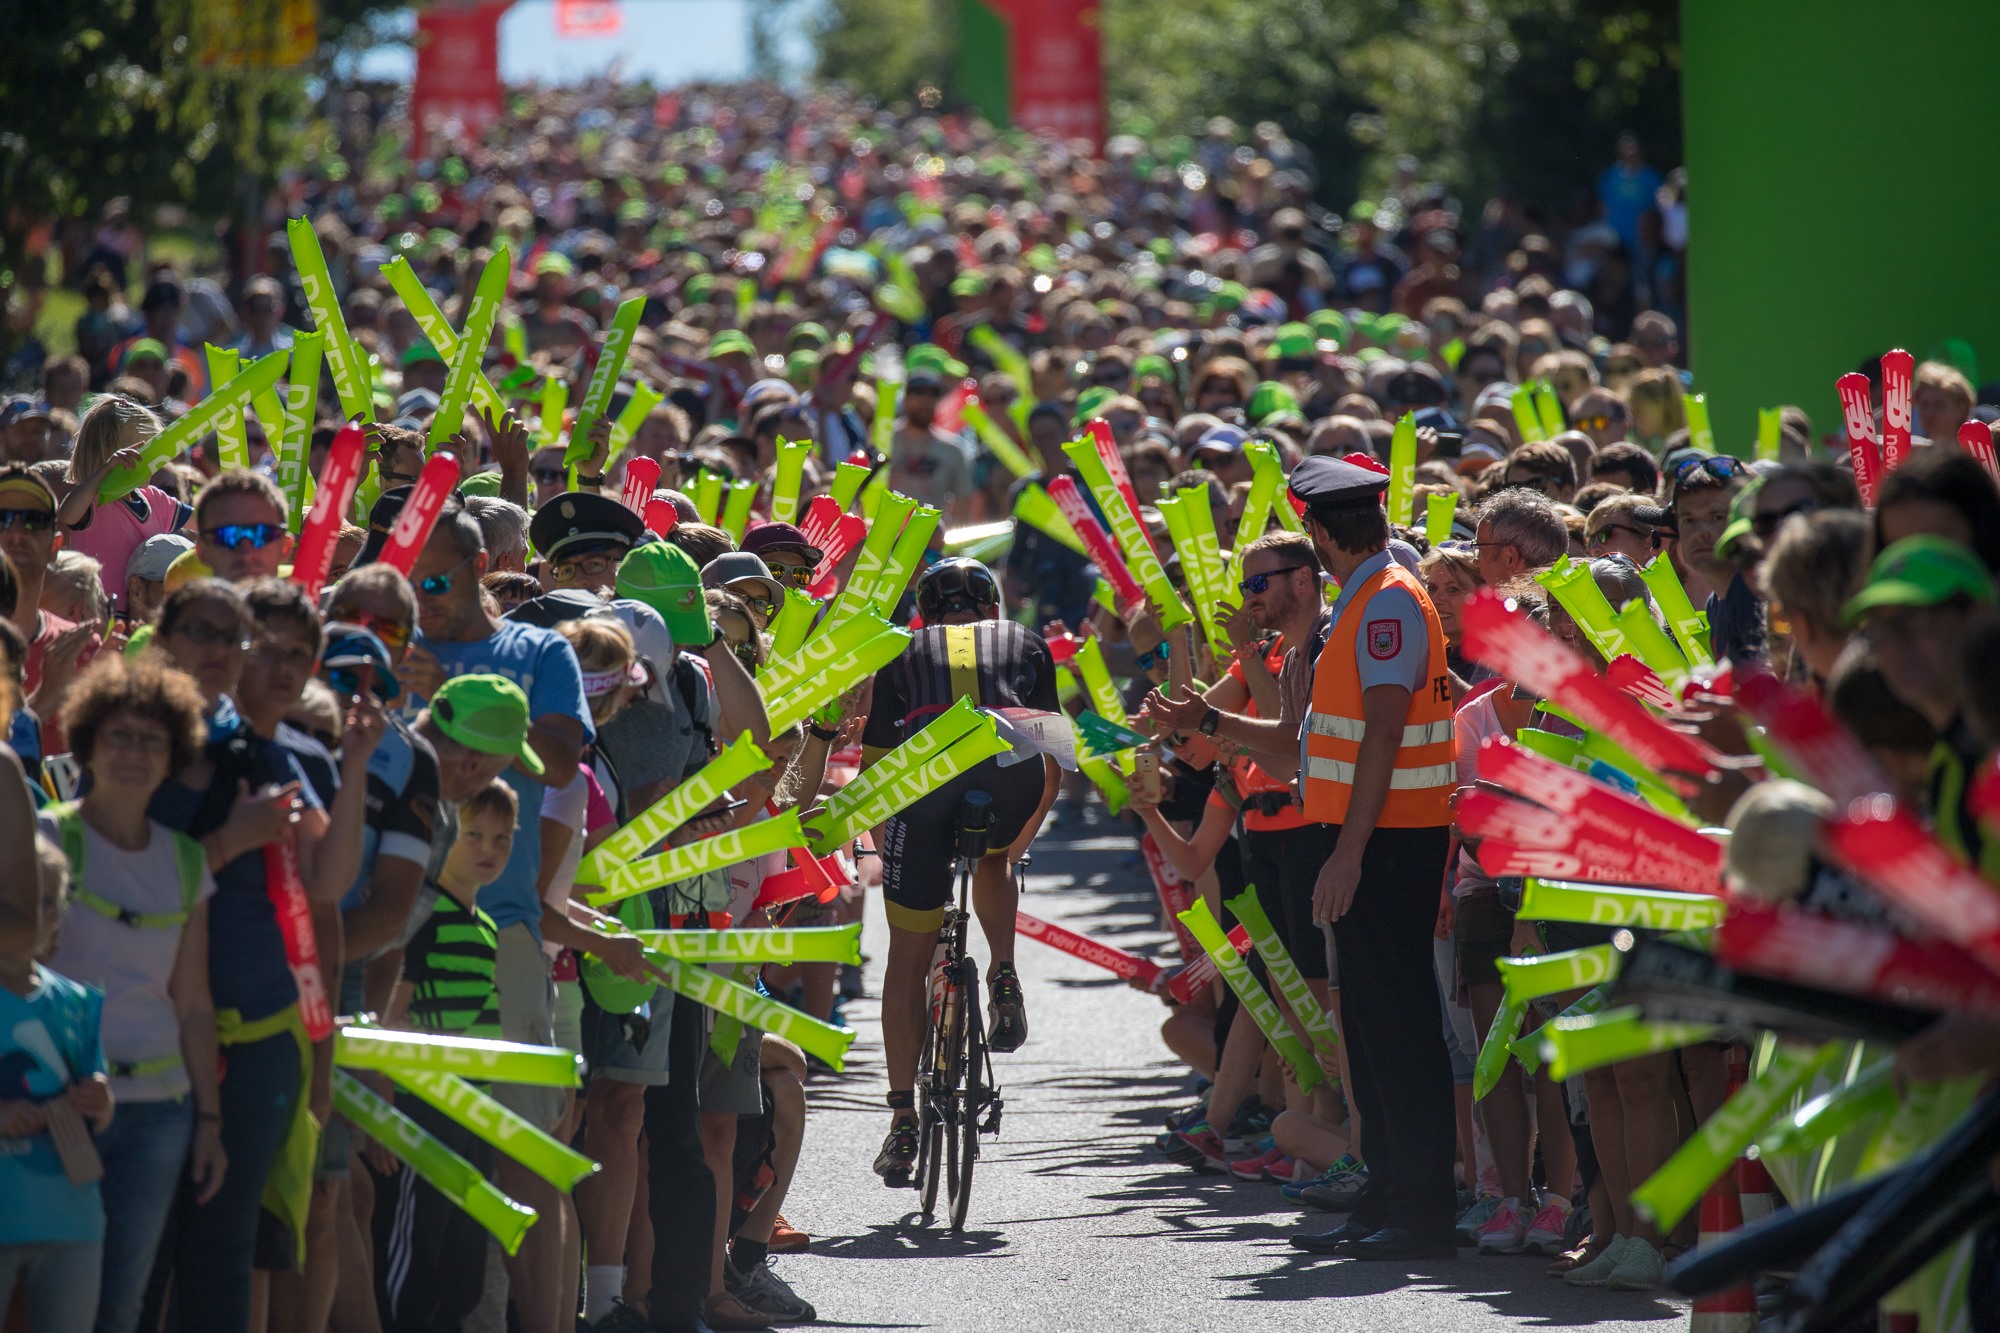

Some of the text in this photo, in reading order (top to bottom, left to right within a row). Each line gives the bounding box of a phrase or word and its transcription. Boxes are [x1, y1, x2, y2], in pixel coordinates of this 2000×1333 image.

[301, 274, 354, 398] DATEV
[282, 384, 311, 514] DATEV
[1852, 446, 1869, 482] new
[1095, 484, 1164, 586] DATEV
[828, 728, 937, 820] DATEV
[846, 750, 959, 836] DATEV
[593, 774, 716, 879] DATEV
[609, 829, 745, 897] DATEV
[893, 820, 908, 858] TRAUN
[650, 931, 794, 958] DATEV
[1045, 929, 1138, 977] new balance
[1235, 936, 1254, 956] ne
[1258, 933, 1331, 1034] DATEV
[662, 959, 794, 1037] DATEV
[1212, 940, 1295, 1041] DATEV
